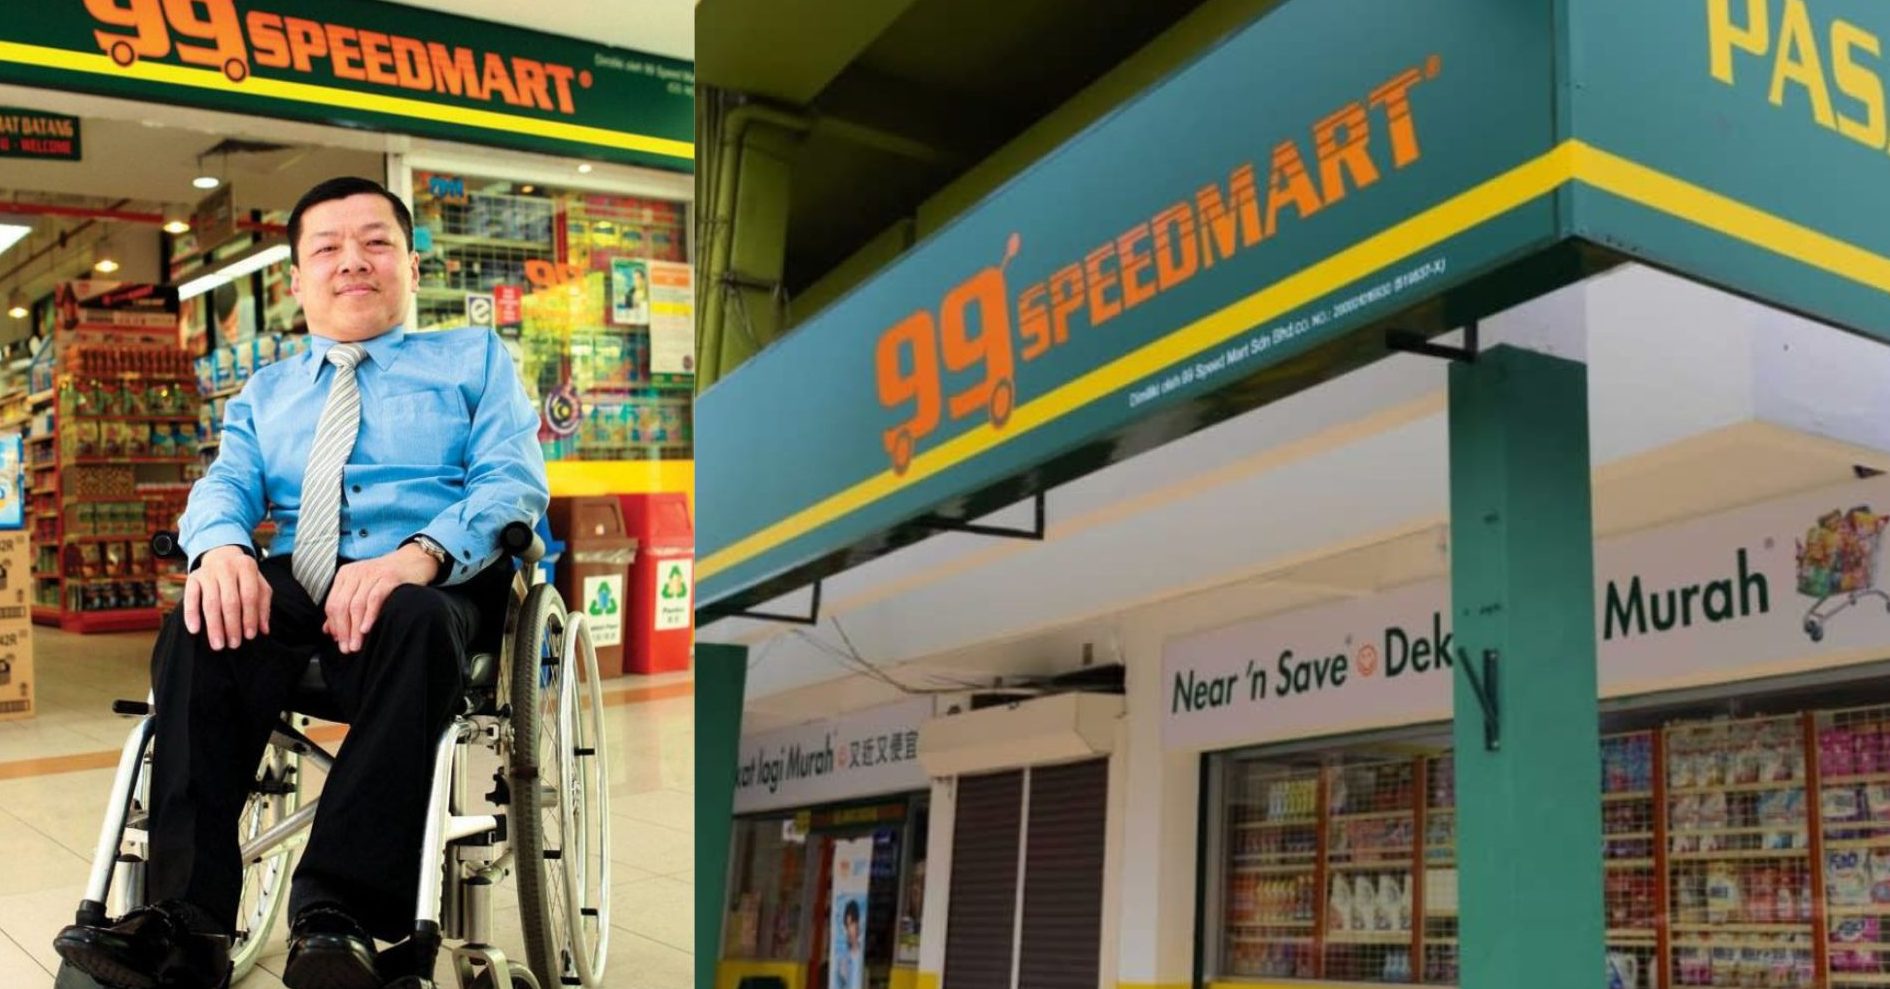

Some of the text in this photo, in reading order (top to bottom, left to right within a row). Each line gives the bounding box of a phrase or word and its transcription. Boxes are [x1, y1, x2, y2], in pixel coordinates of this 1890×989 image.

[82, 0, 576, 116] 99 SPEEDMART
[1707, 0, 1890, 156] PAS
[0, 115, 19, 133] AT
[875, 67, 1422, 476] 99 SPEEDMART
[1195, 353, 1225, 380] Speed
[1226, 344, 1249, 365] Mart
[1251, 335, 1271, 354] Sdn
[1172, 669, 1238, 714] Near
[1275, 650, 1347, 697] Save
[1385, 611, 1454, 678] Dek
[1604, 547, 1769, 640] Murah
[756, 747, 784, 794] lagi
[785, 732, 833, 781] Murah
[848, 730, 919, 769] 又近又便宜
